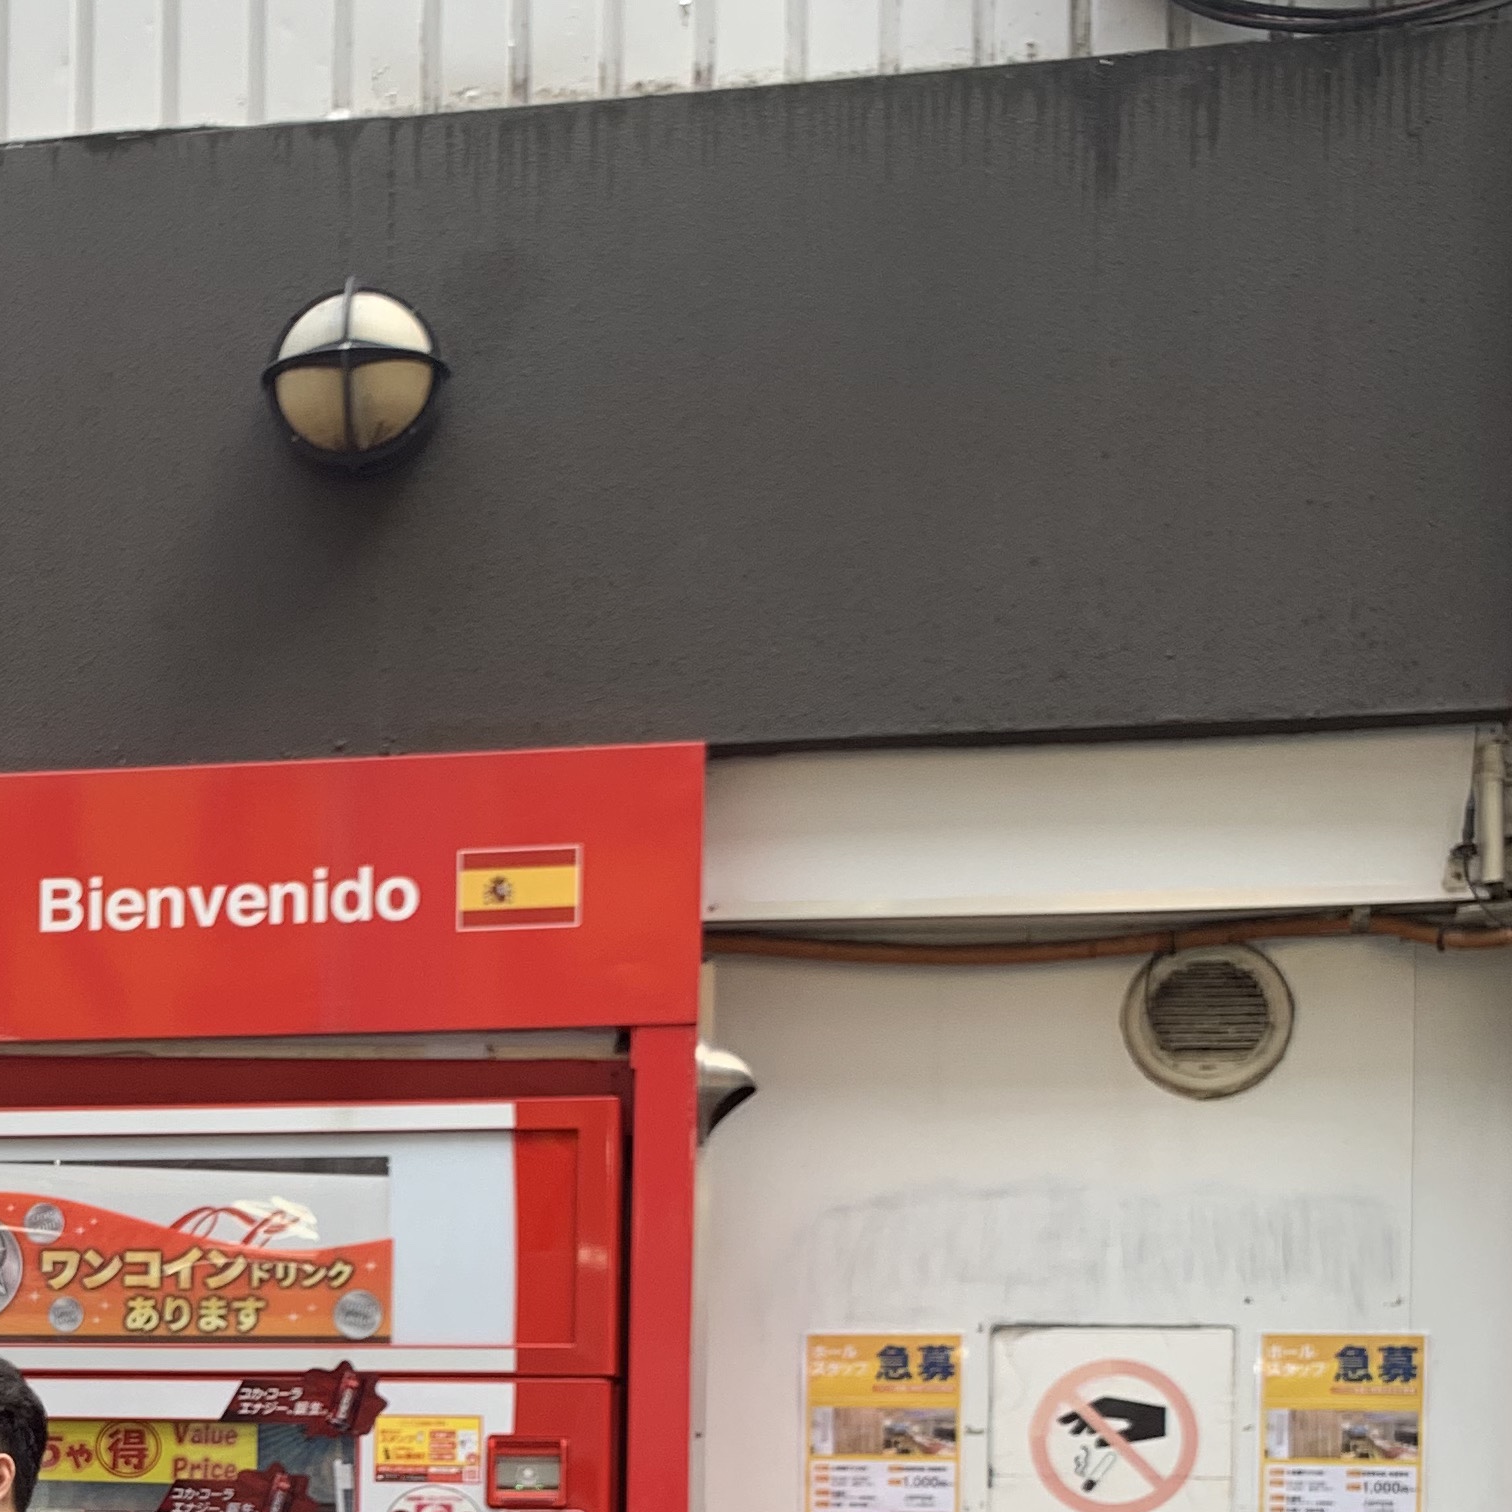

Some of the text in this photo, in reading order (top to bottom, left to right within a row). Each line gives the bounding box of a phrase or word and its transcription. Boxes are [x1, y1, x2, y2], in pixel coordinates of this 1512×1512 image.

[39, 865, 420, 933] Bienvenido
[41, 1247, 354, 1290] ワンコインドリンク
[124, 1295, 268, 1332] あります
[173, 1456, 238, 1480] Price
